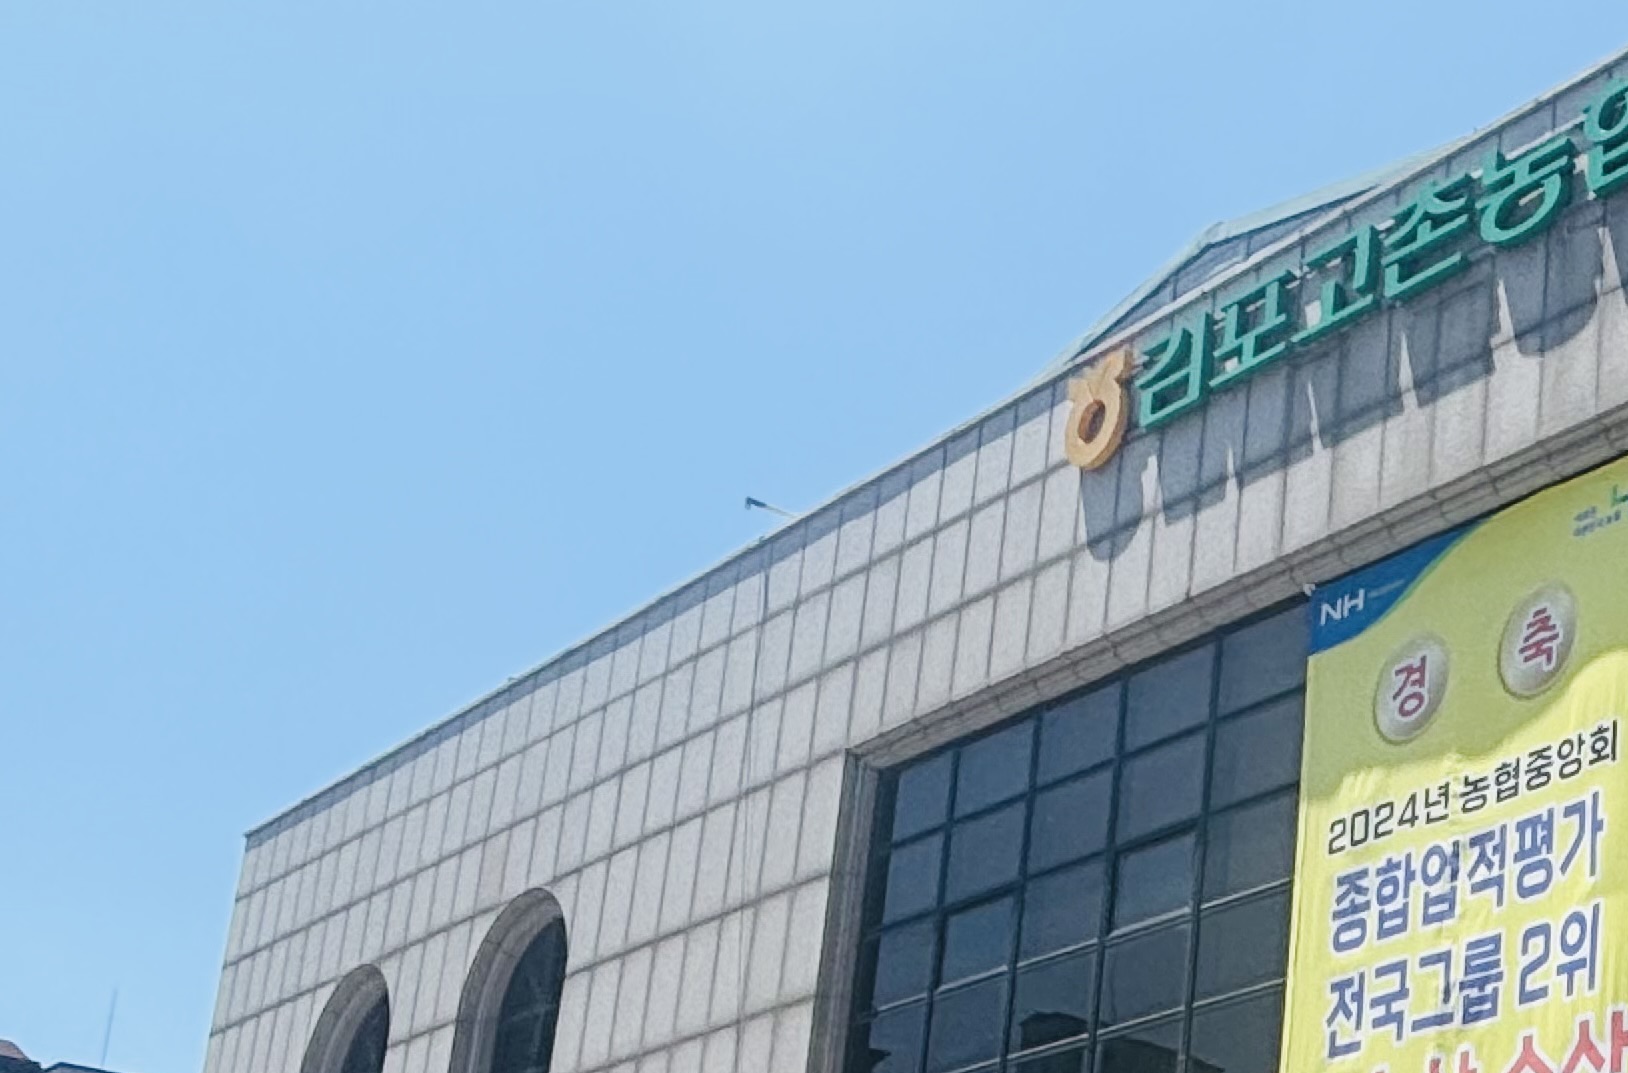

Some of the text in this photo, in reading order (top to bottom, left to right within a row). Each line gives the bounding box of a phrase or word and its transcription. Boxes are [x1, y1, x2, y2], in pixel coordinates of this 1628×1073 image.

[1320, 588, 1365, 626] NH
[1518, 606, 1561, 668] 축
[1392, 654, 1428, 718] 경
[1328, 720, 1619, 854] 2024년 농협중앙회
[1331, 792, 1604, 953] 종합업적평가
[1325, 903, 1601, 1059] 전국그룹 2위
